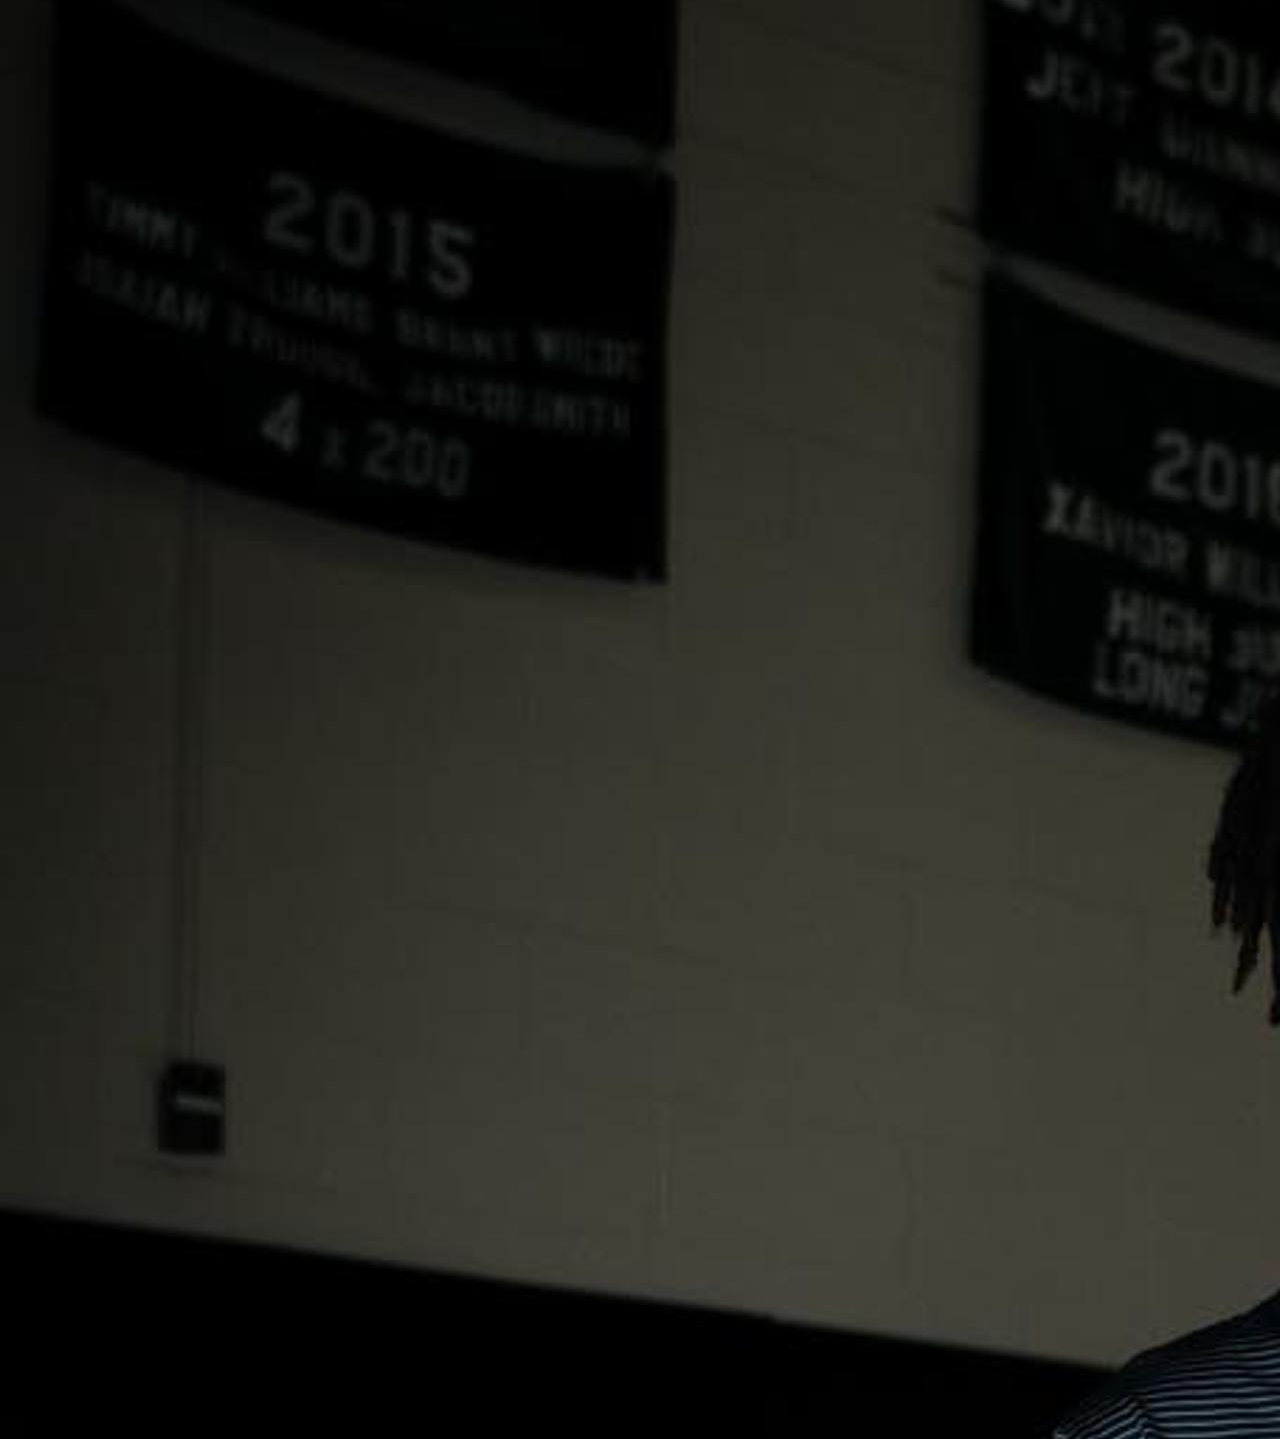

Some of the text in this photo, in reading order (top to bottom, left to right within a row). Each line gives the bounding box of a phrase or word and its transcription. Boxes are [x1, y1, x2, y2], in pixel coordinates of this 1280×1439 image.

[262, 169, 475, 299] 2015
[259, 391, 304, 455] 4
[362, 416, 473, 502] 200
[1106, 583, 1213, 663] HIGH
[1091, 638, 1211, 724] LONG
